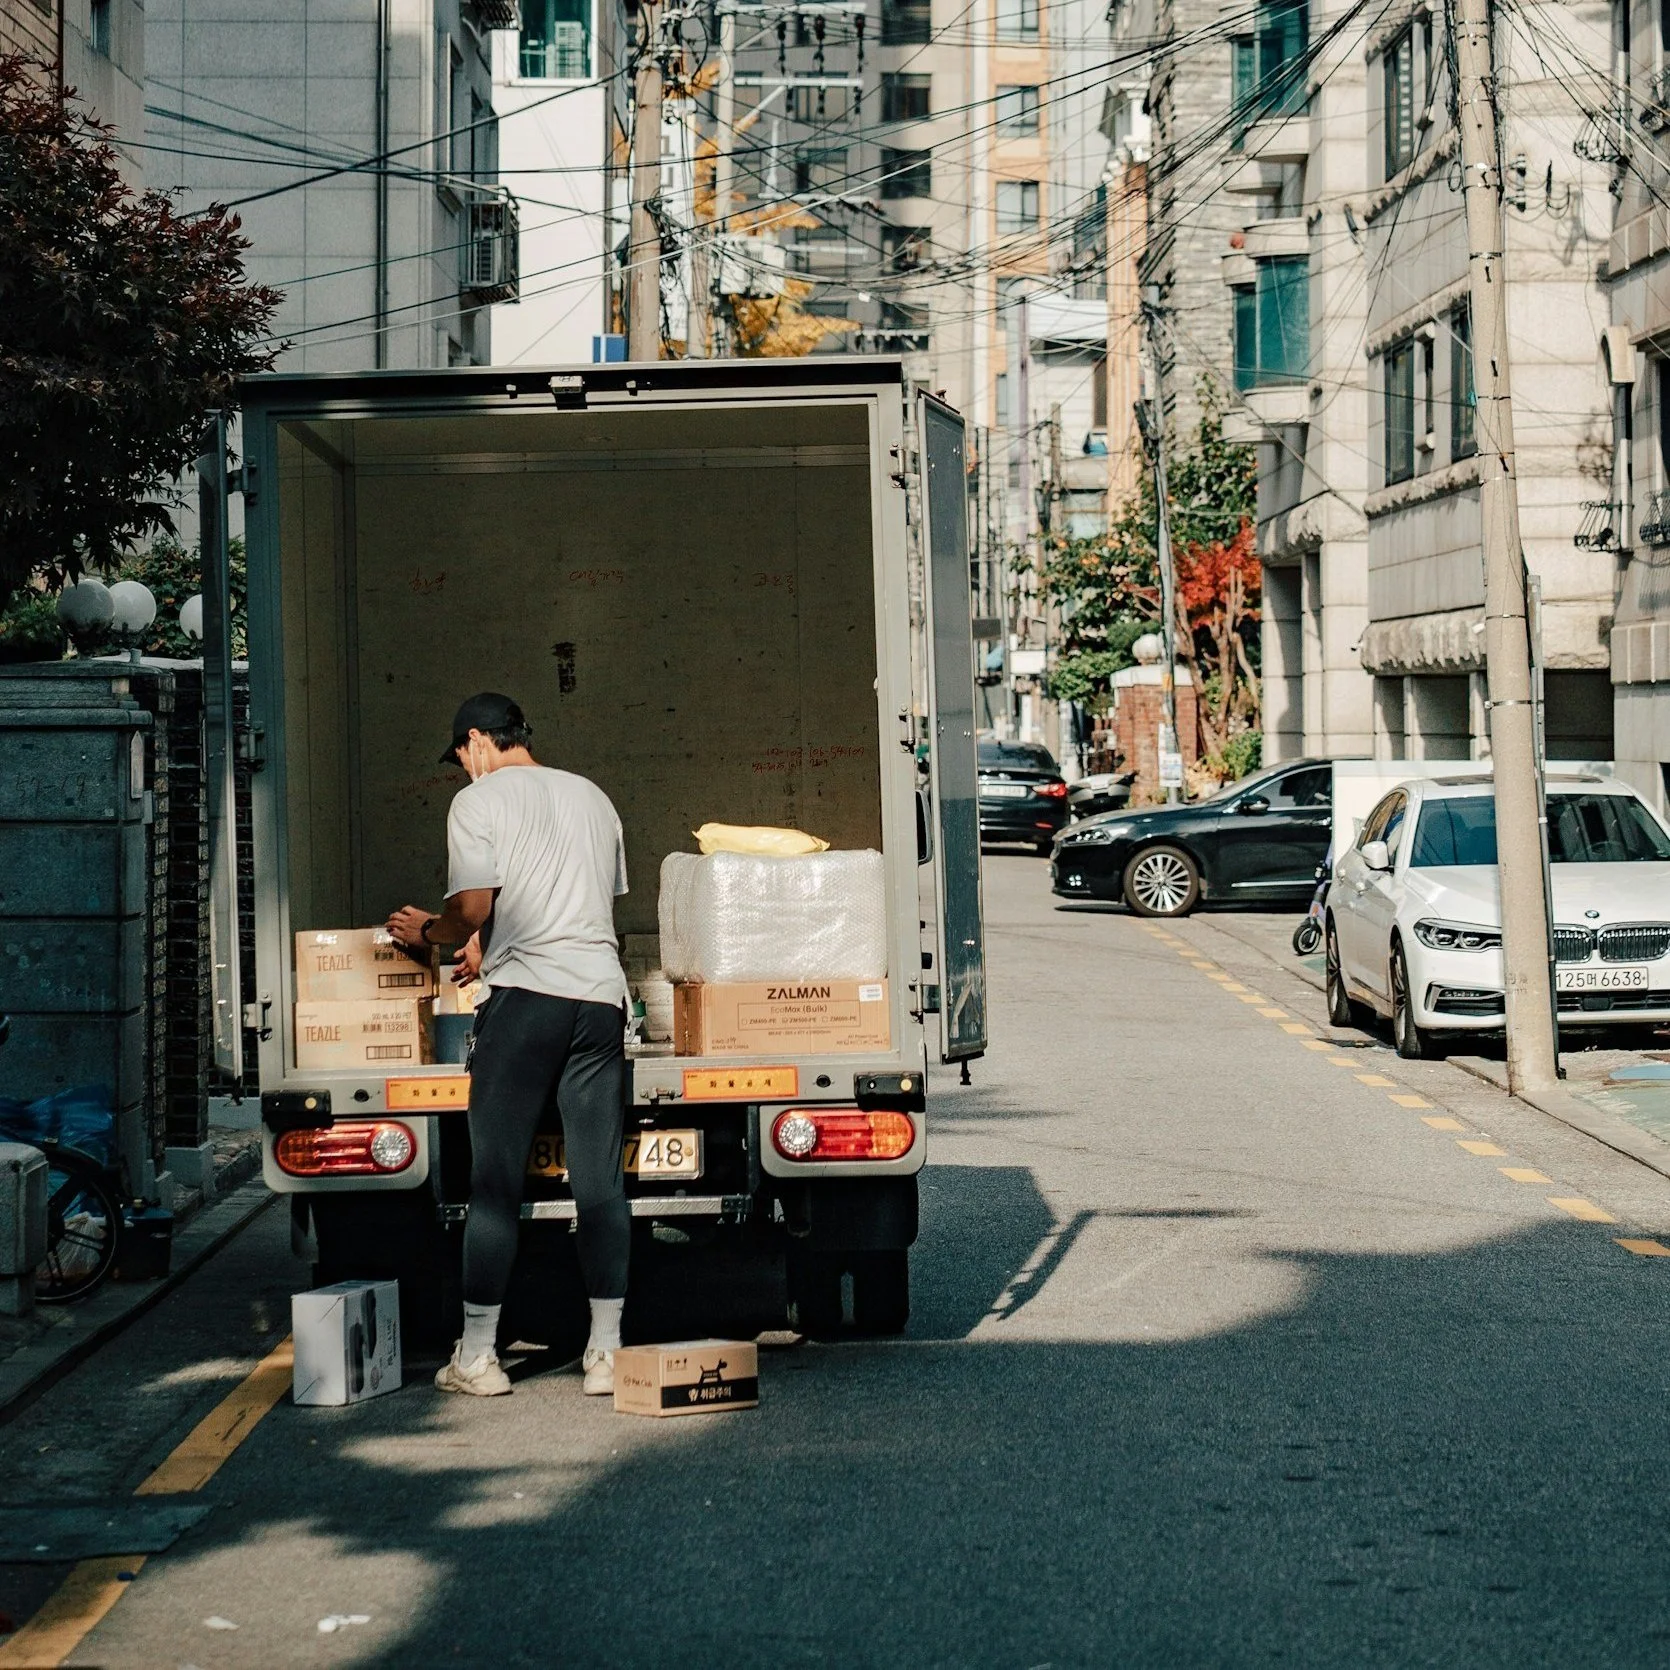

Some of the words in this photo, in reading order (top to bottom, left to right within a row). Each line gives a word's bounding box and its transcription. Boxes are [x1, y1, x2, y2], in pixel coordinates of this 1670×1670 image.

[316, 953, 353, 972] TEAZLE
[1601, 970, 1642, 987] 6638
[767, 986, 831, 1000] ZALMAN
[770, 1006, 800, 1014] EcoMax
[802, 1005, 828, 1013] (Bulk)
[304, 1025, 341, 1043] TEAZLE
[700, 1385, 732, 1400] 취급주의
